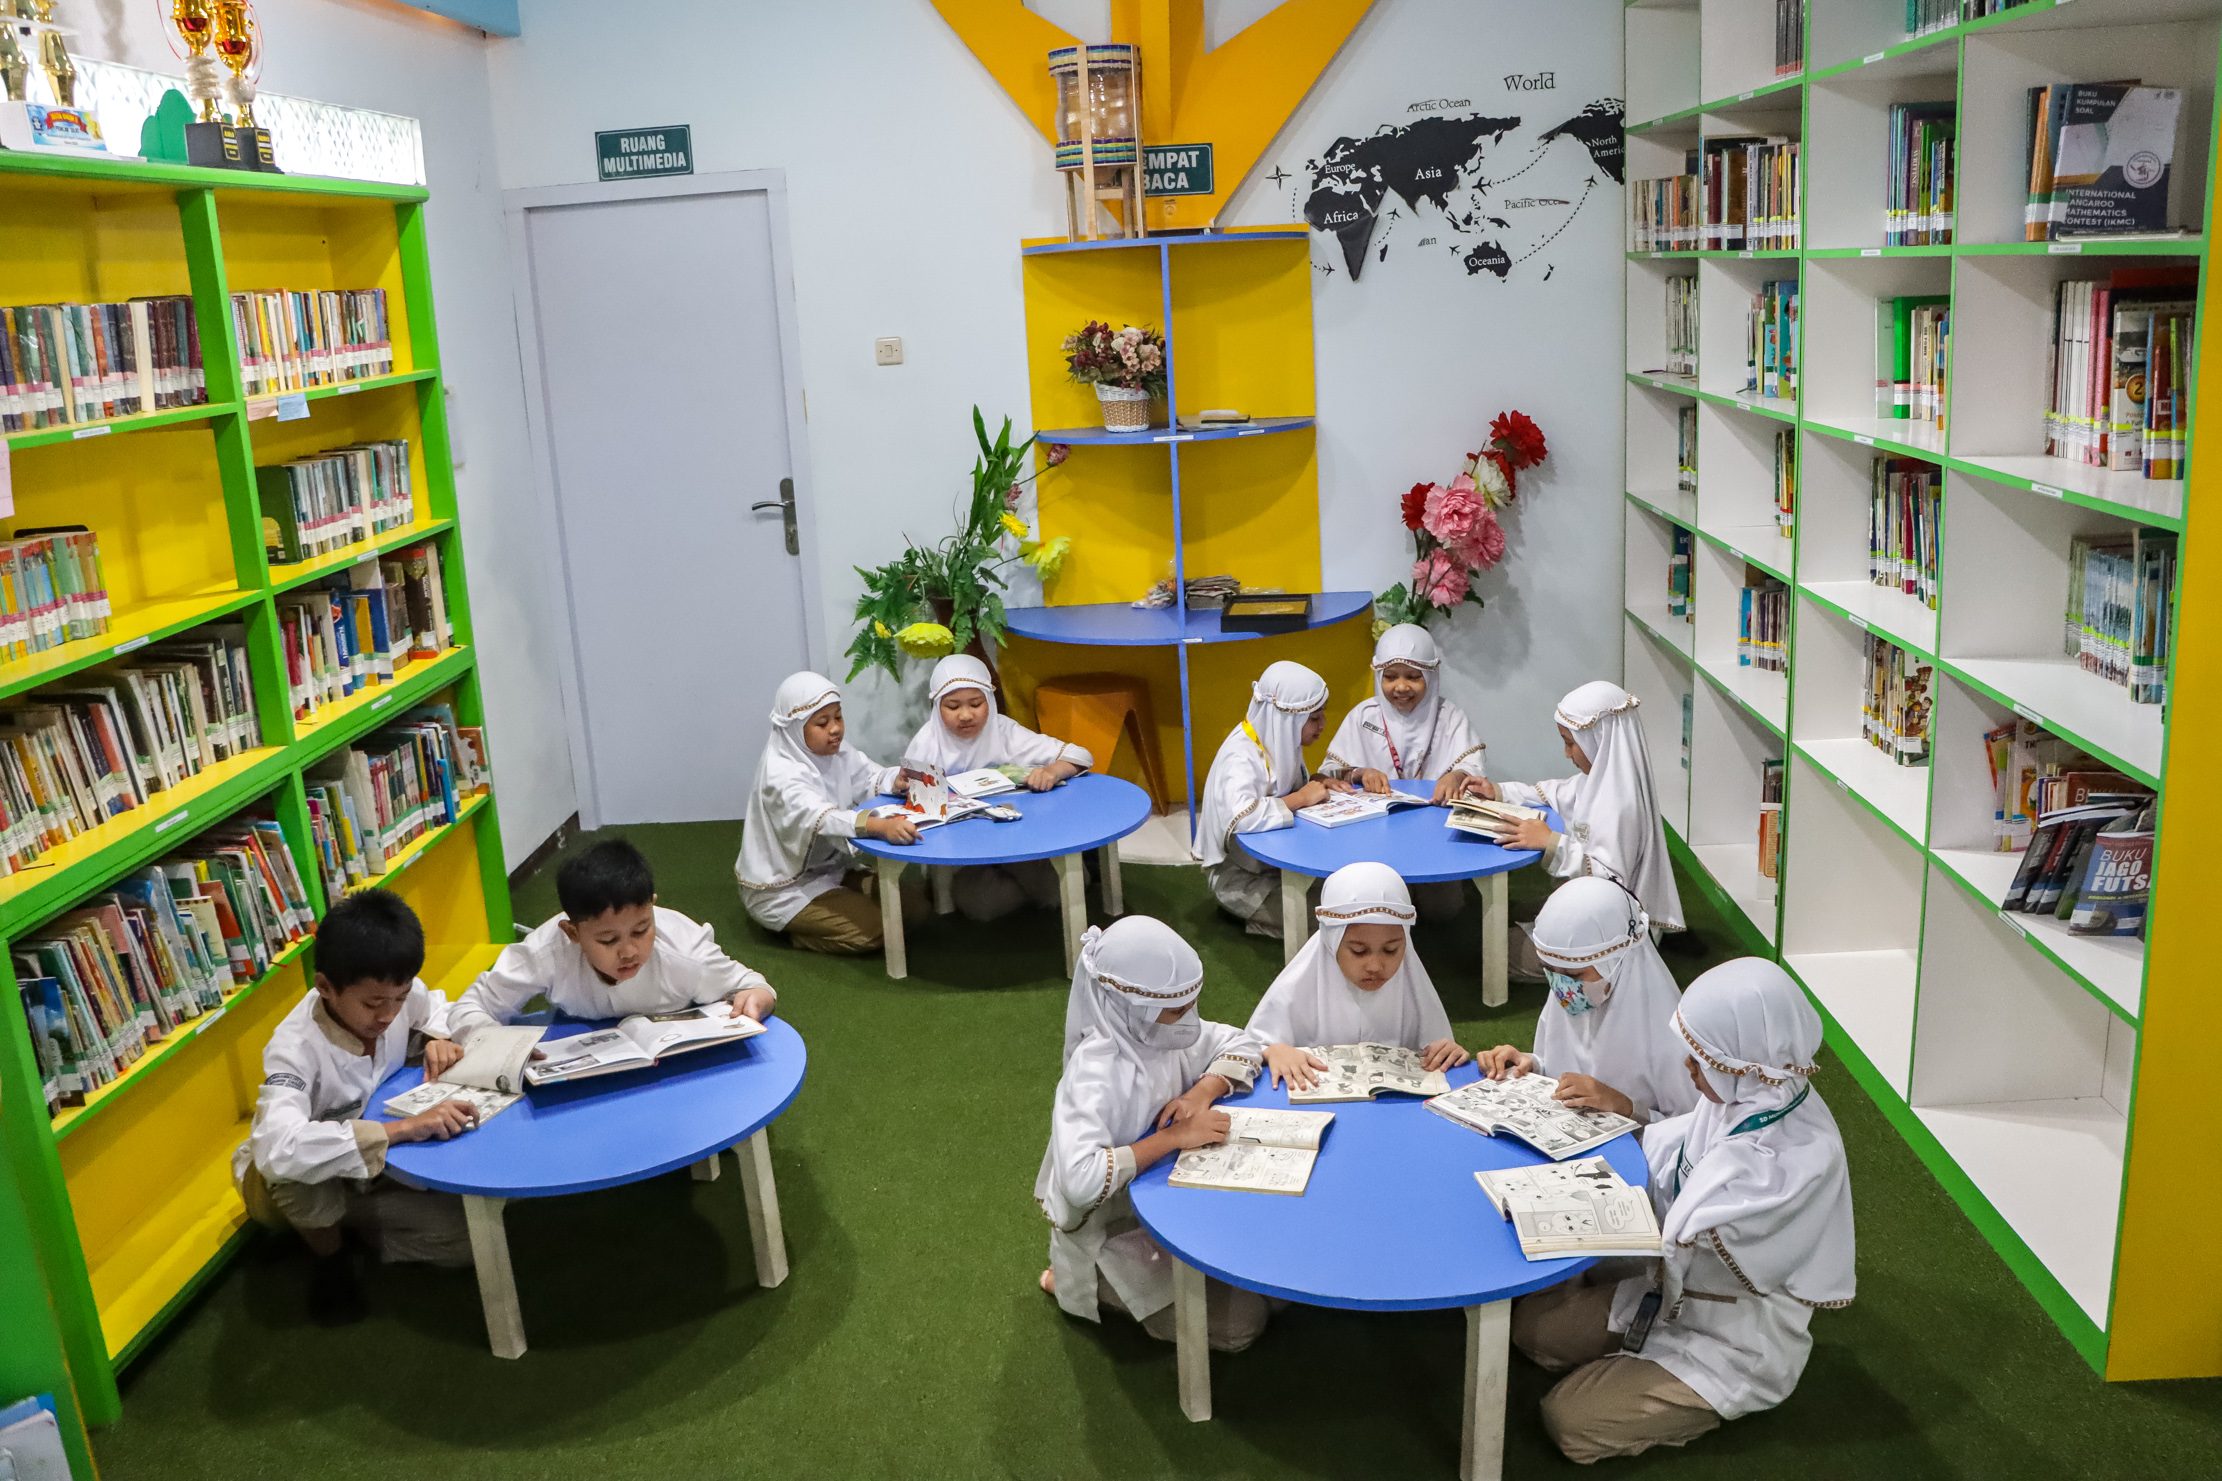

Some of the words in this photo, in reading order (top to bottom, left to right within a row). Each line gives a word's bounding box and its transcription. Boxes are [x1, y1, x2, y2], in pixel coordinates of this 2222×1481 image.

[1503, 72, 1556, 91] World
[1406, 100, 1437, 112] Arctic
[1439, 98, 1471, 109] Ocean
[620, 134, 666, 153] RUANG
[1591, 134, 1617, 147] North
[1593, 145, 1625, 158] Americ
[603, 152, 687, 173] MULTIMEDIA
[1143, 150, 1200, 169] EMPAT
[1325, 163, 1356, 174] Europe
[1414, 166, 1442, 180] Asia
[1504, 198, 1536, 209] Pacific
[2069, 199, 2115, 208] ANGAROO
[1323, 211, 1359, 224] Africa
[1468, 255, 1505, 267] Oceania
[2134, 381, 2143, 395] 2
[2100, 847, 2147, 861] BUKU
[2095, 860, 2143, 877] JAGO
[2091, 874, 2151, 892] FUTS
